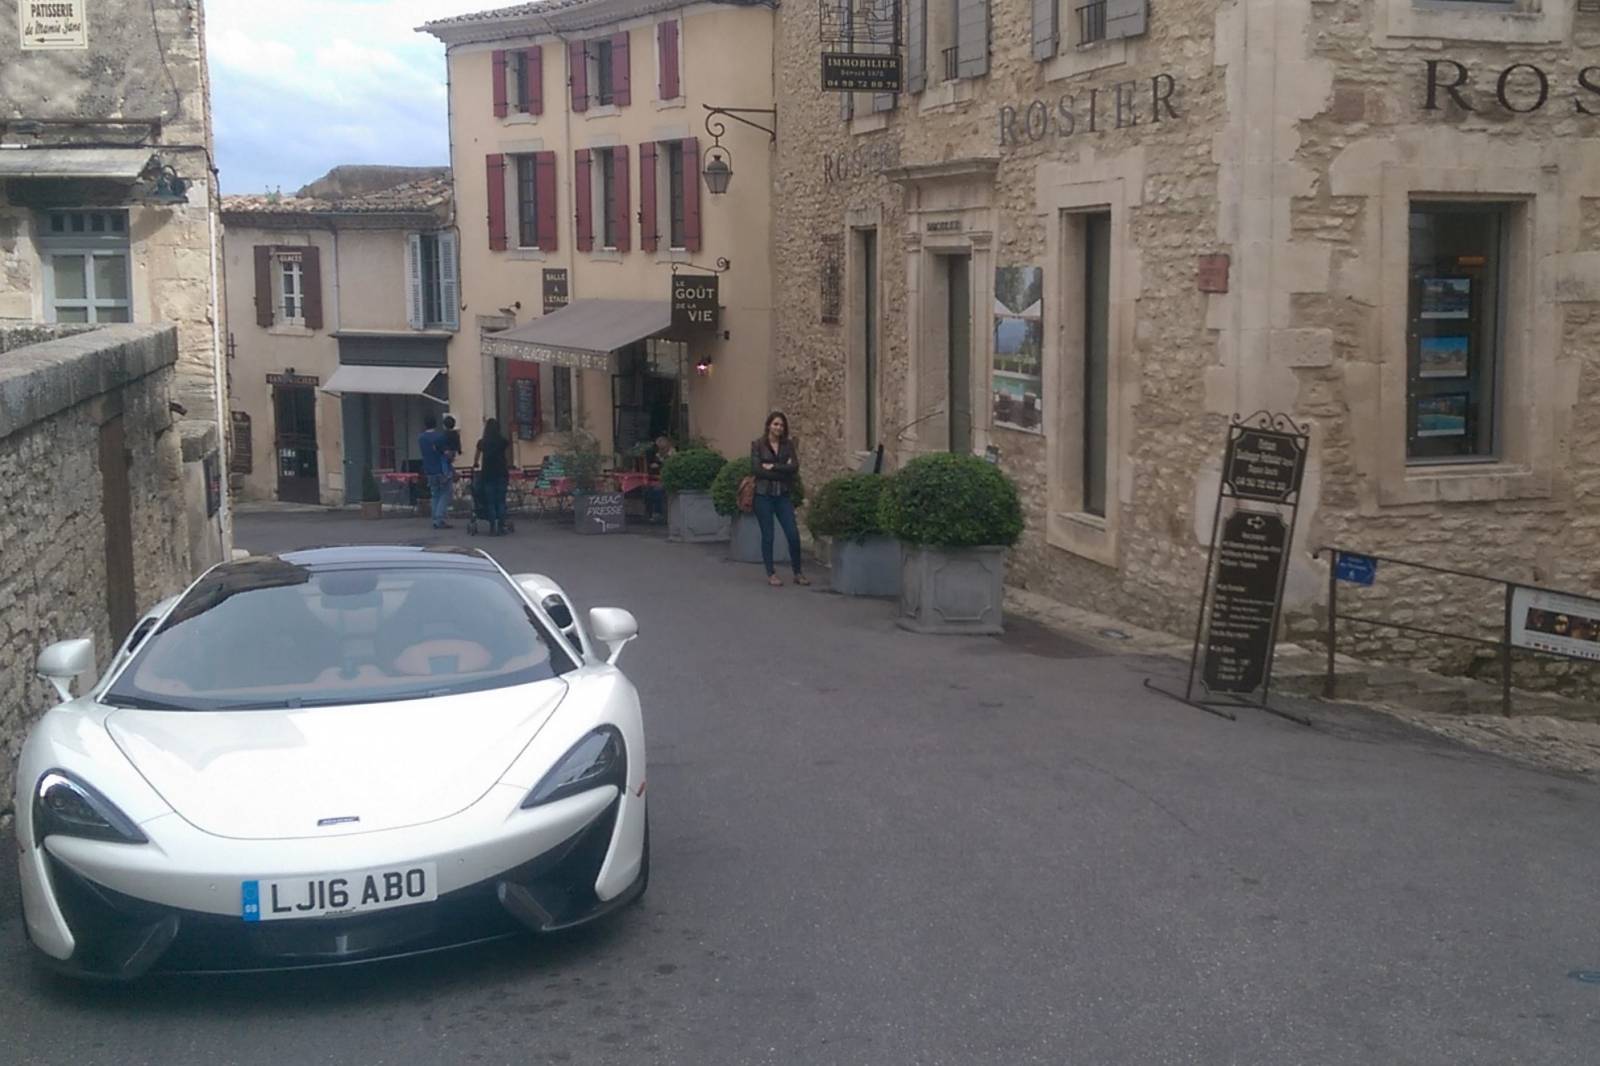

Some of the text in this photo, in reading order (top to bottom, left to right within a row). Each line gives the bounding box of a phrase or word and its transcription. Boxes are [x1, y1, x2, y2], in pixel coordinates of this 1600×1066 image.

[31, 3, 73, 17] PATISSERIE
[25, 22, 33, 35] de
[828, 58, 896, 68] IMMOBILIER
[999, 73, 1180, 147] ROSIER
[546, 273, 566, 281] SALLE
[688, 310, 713, 321] VIE
[589, 495, 622, 505] TABAC
[586, 505, 624, 516] PRESSE
[271, 878, 349, 913] LJ16
